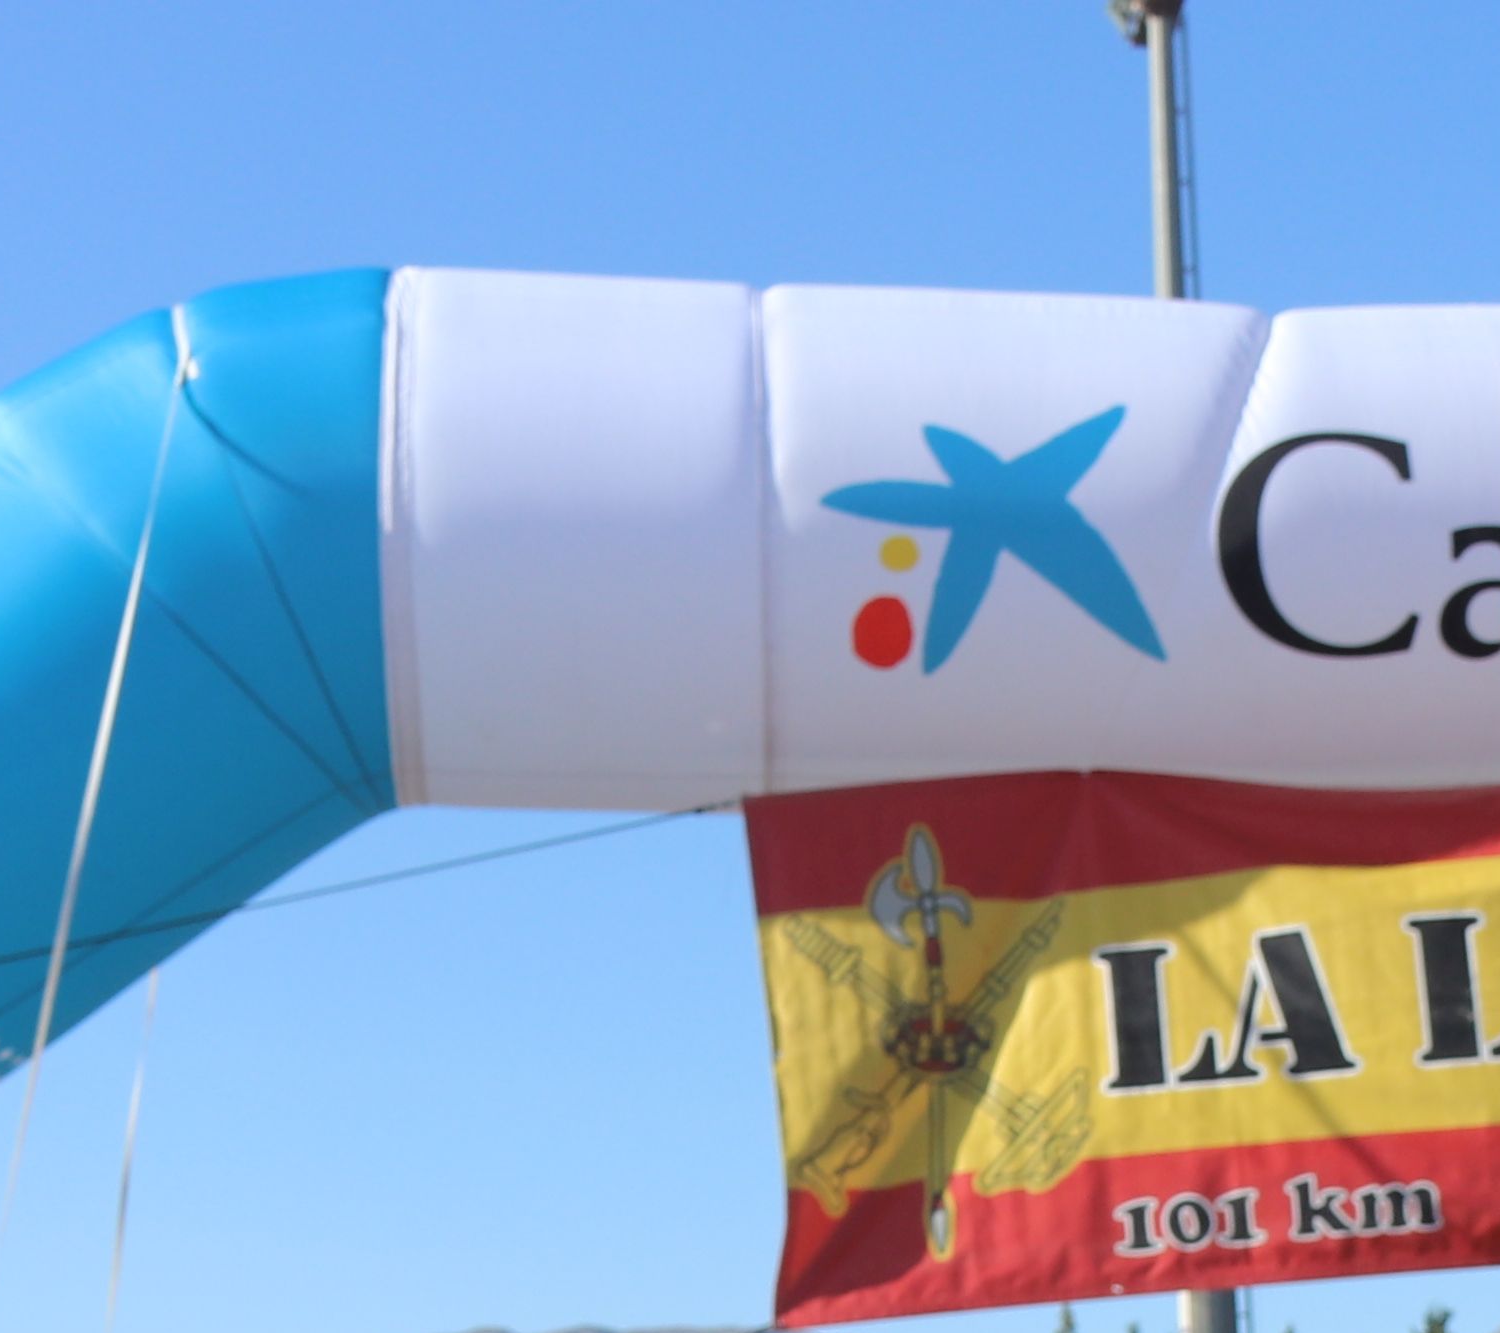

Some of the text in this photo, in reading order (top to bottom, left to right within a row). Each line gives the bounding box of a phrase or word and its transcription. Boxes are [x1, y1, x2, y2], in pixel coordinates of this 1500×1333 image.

[1098, 922, 1360, 1096] LA
[1113, 1173, 1445, 1258] 101 km
